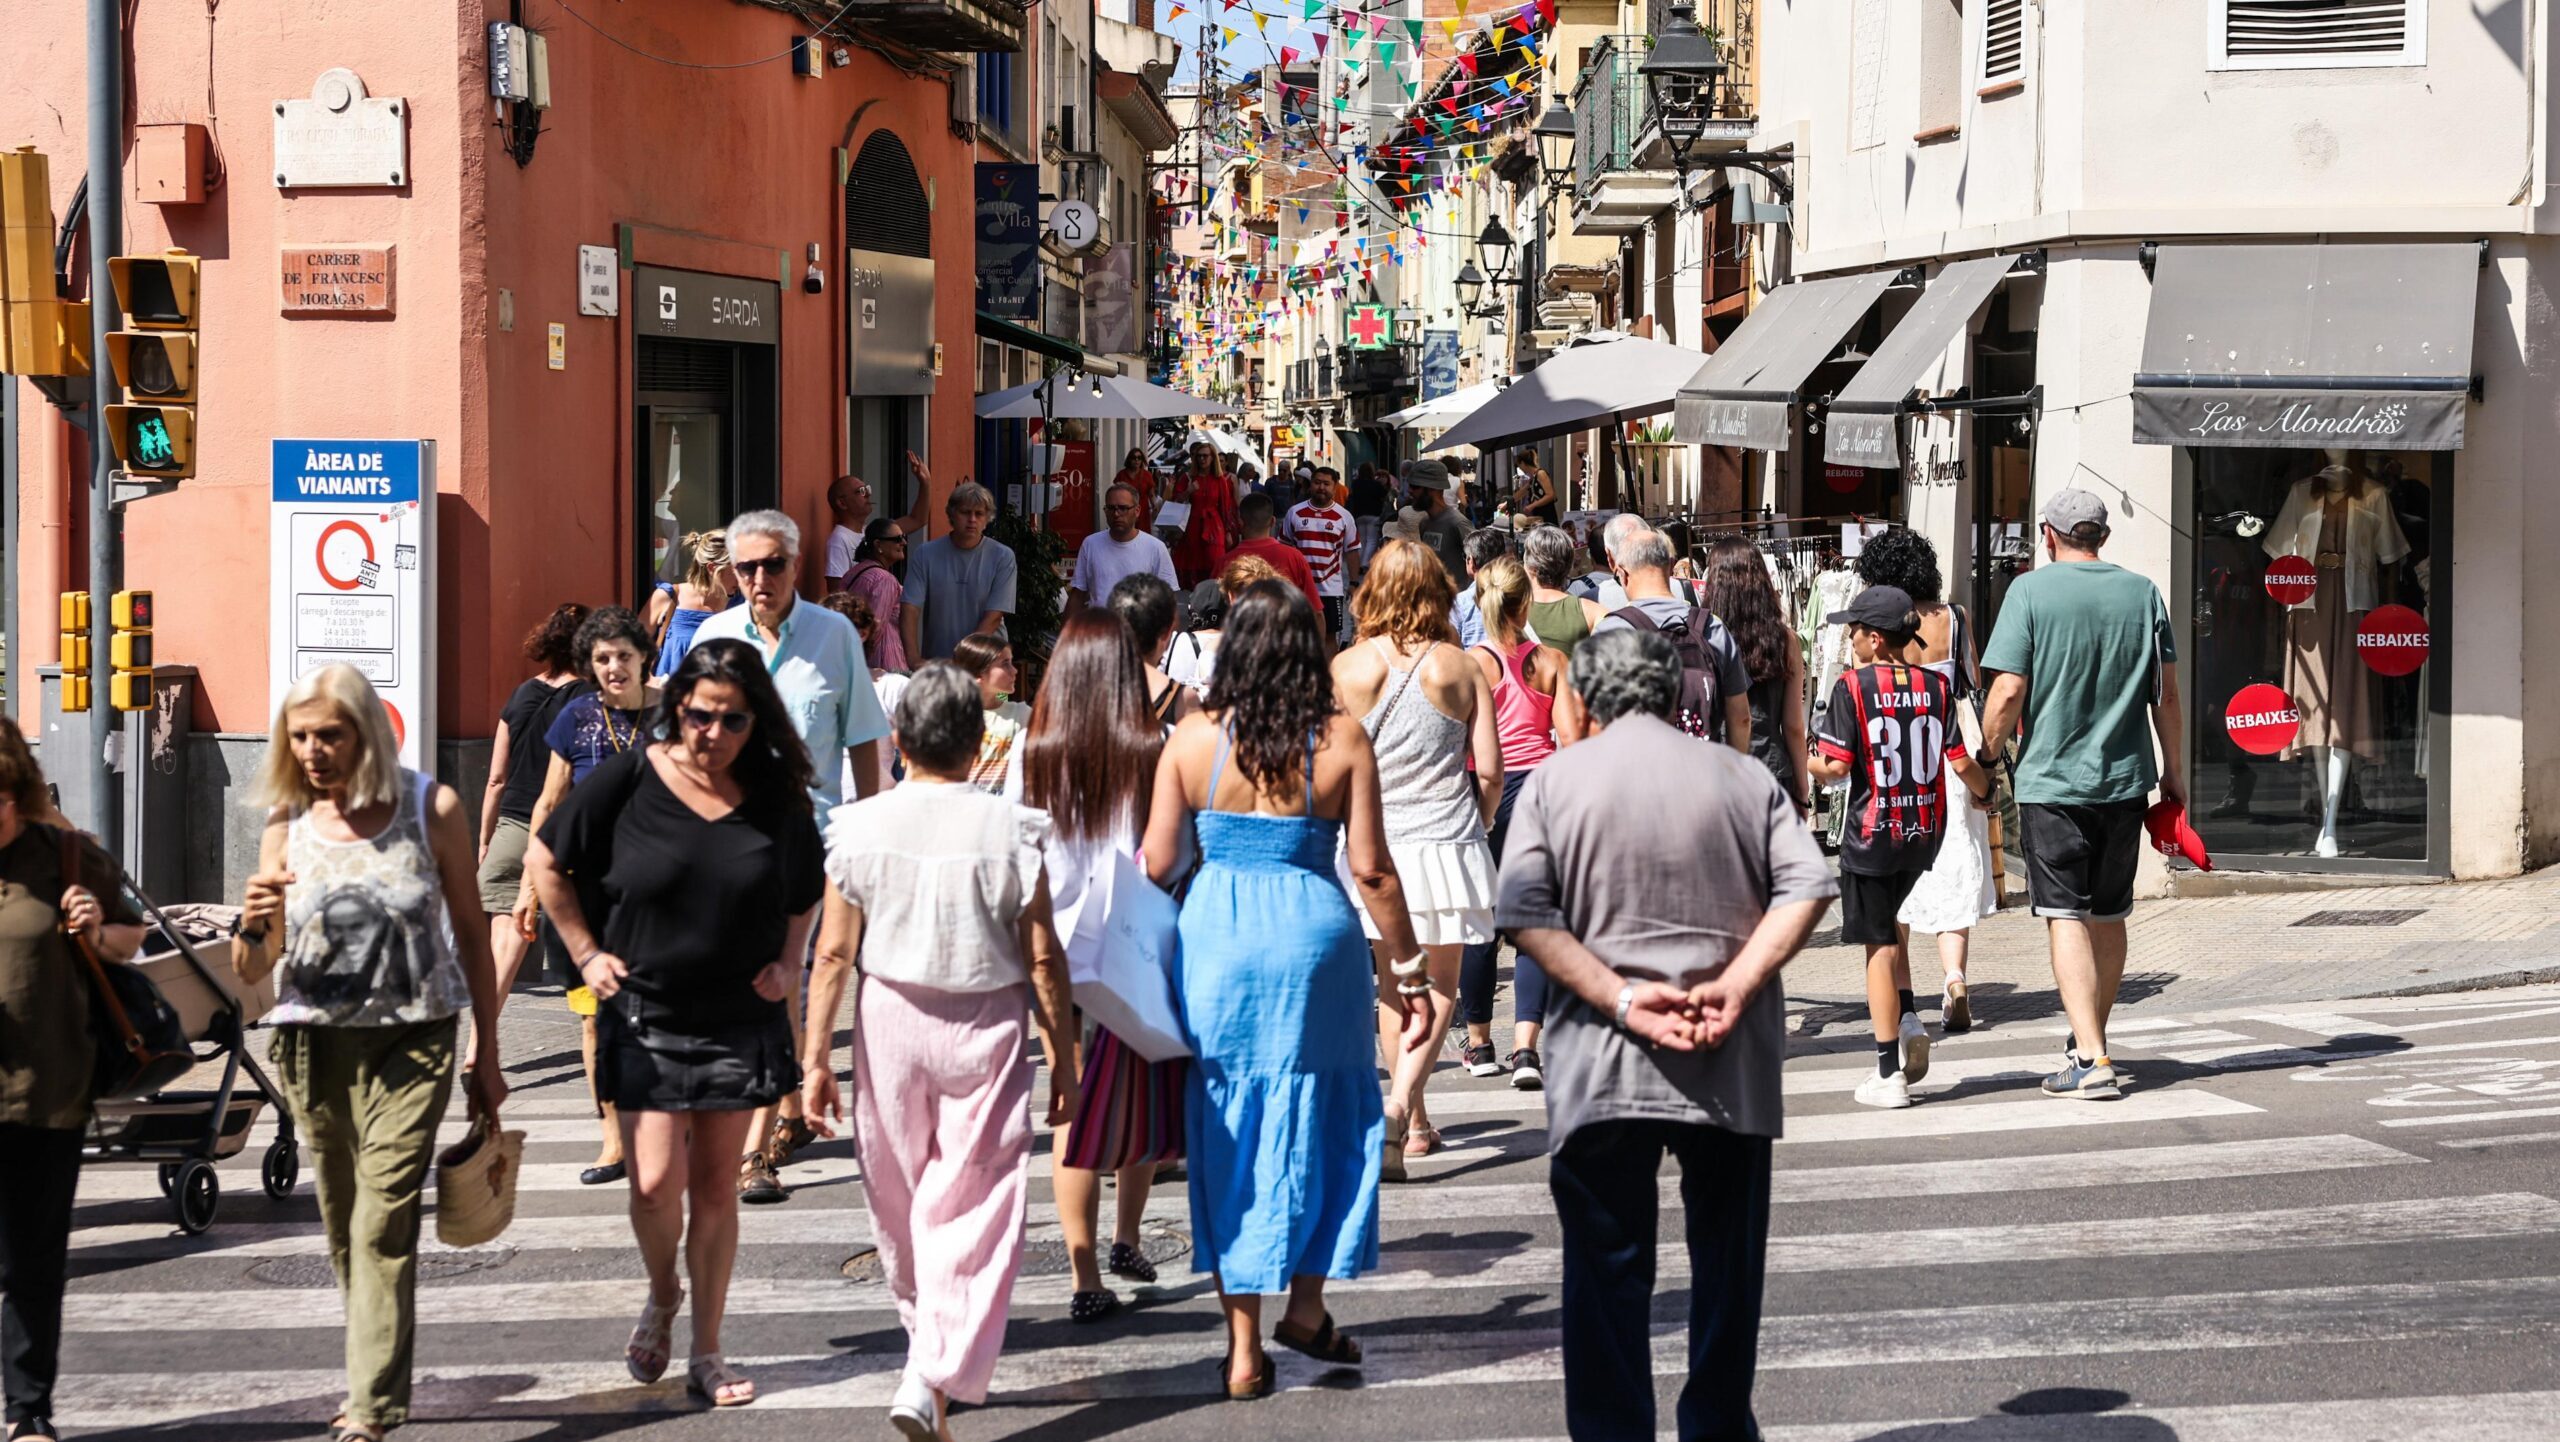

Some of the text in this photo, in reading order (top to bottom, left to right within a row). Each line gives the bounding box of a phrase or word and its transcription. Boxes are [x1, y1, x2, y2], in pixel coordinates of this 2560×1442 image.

[996, 210, 1031, 228] Vila
[307, 254, 360, 266] CARRER
[284, 272, 385, 285] DE FRANCESC
[299, 293, 365, 306] MORAGAS
[2189, 402, 2405, 436] Las Alondras
[1835, 425, 1849, 457] Las
[305, 449, 383, 472] ÀREA DE
[1825, 469, 1865, 478] REBAIXES
[297, 477, 391, 495] VIANANTS
[360, 569, 377, 579] ANTI
[2265, 575, 2317, 585] REBAIXES
[330, 597, 360, 606] Excepte
[324, 628, 332, 636] 14
[2357, 634, 2429, 647] REBAIXES
[1874, 692, 1931, 708] LOZANO
[2226, 709, 2298, 729] REBAIXES
[1867, 714, 1943, 788] 30
[1891, 795, 1913, 807] SANT
